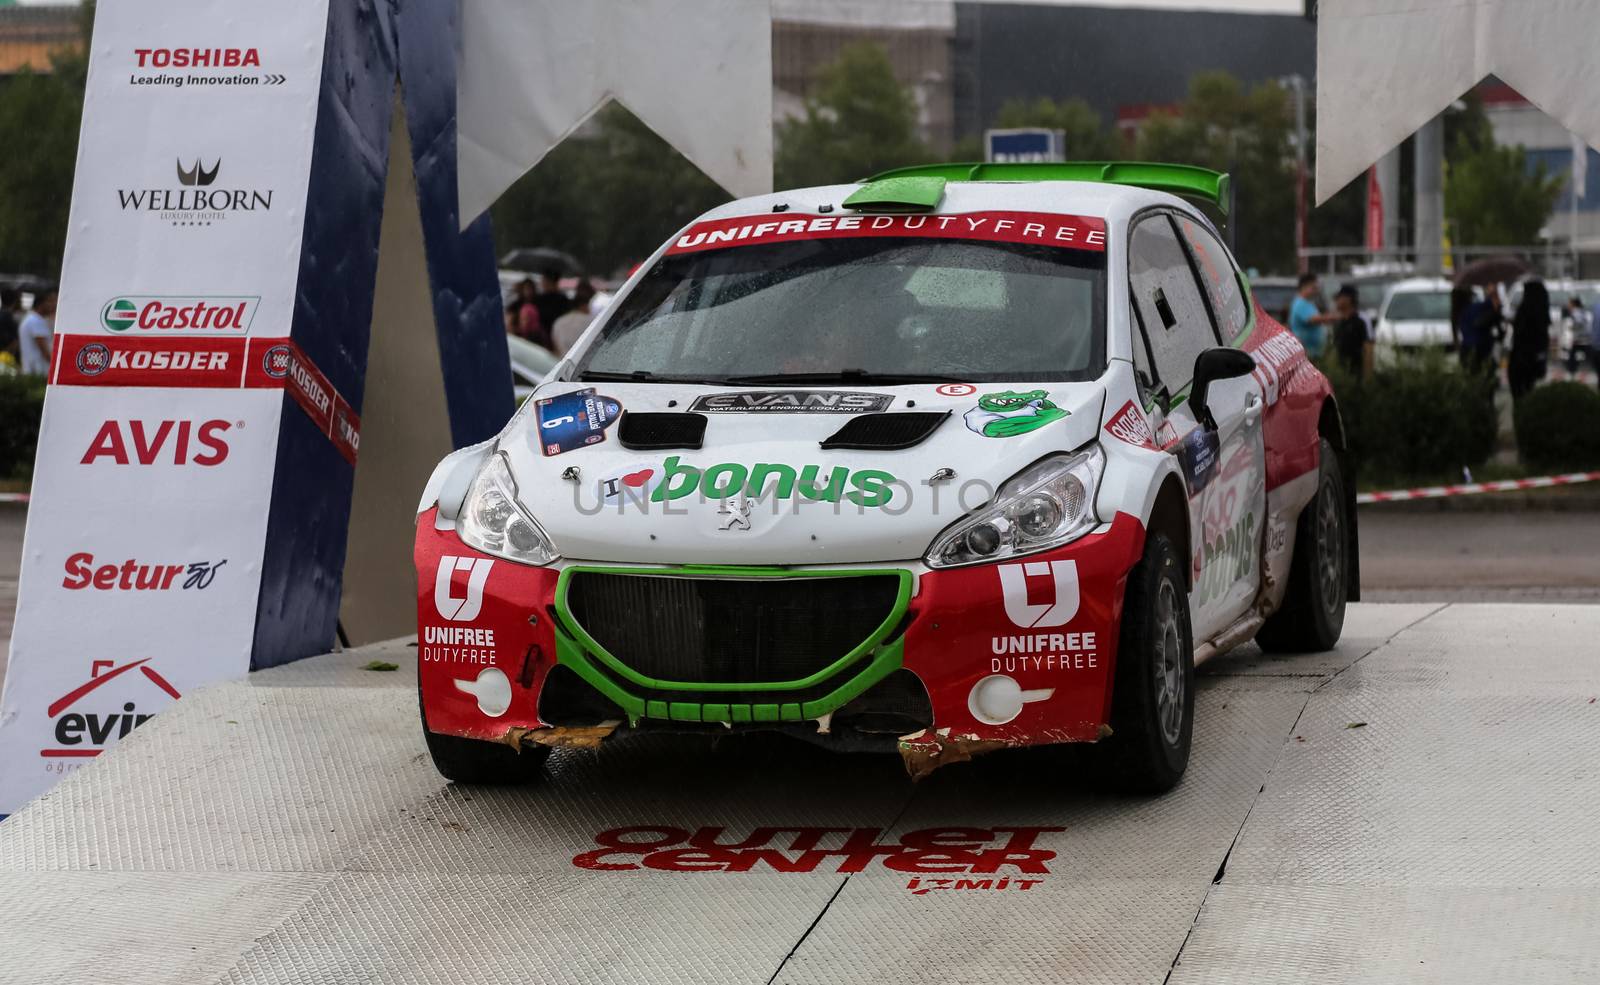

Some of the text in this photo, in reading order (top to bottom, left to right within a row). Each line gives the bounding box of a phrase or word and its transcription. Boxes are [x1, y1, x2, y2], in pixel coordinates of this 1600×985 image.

[134, 48, 261, 68] TOSHIBA
[129, 74, 259, 87] Leading Innovation
[117, 189, 273, 211] WELLBORN
[160, 211, 227, 220] LUXURY HOTEL
[675, 215, 1106, 248] UNIFREE DUTYFREE
[138, 301, 247, 330] Castrol
[109, 350, 230, 370] KOSDER
[290, 358, 329, 415] KOSDER
[705, 394, 876, 407] EVANS
[79, 419, 233, 466] AVIS
[650, 455, 895, 508] bonus
[62, 552, 184, 590] Setur
[424, 626, 496, 647] UNIFREE
[992, 631, 1097, 655] UNIFREE
[424, 647, 496, 665] DUTYFREE
[991, 653, 1098, 673] DUTYFREE
